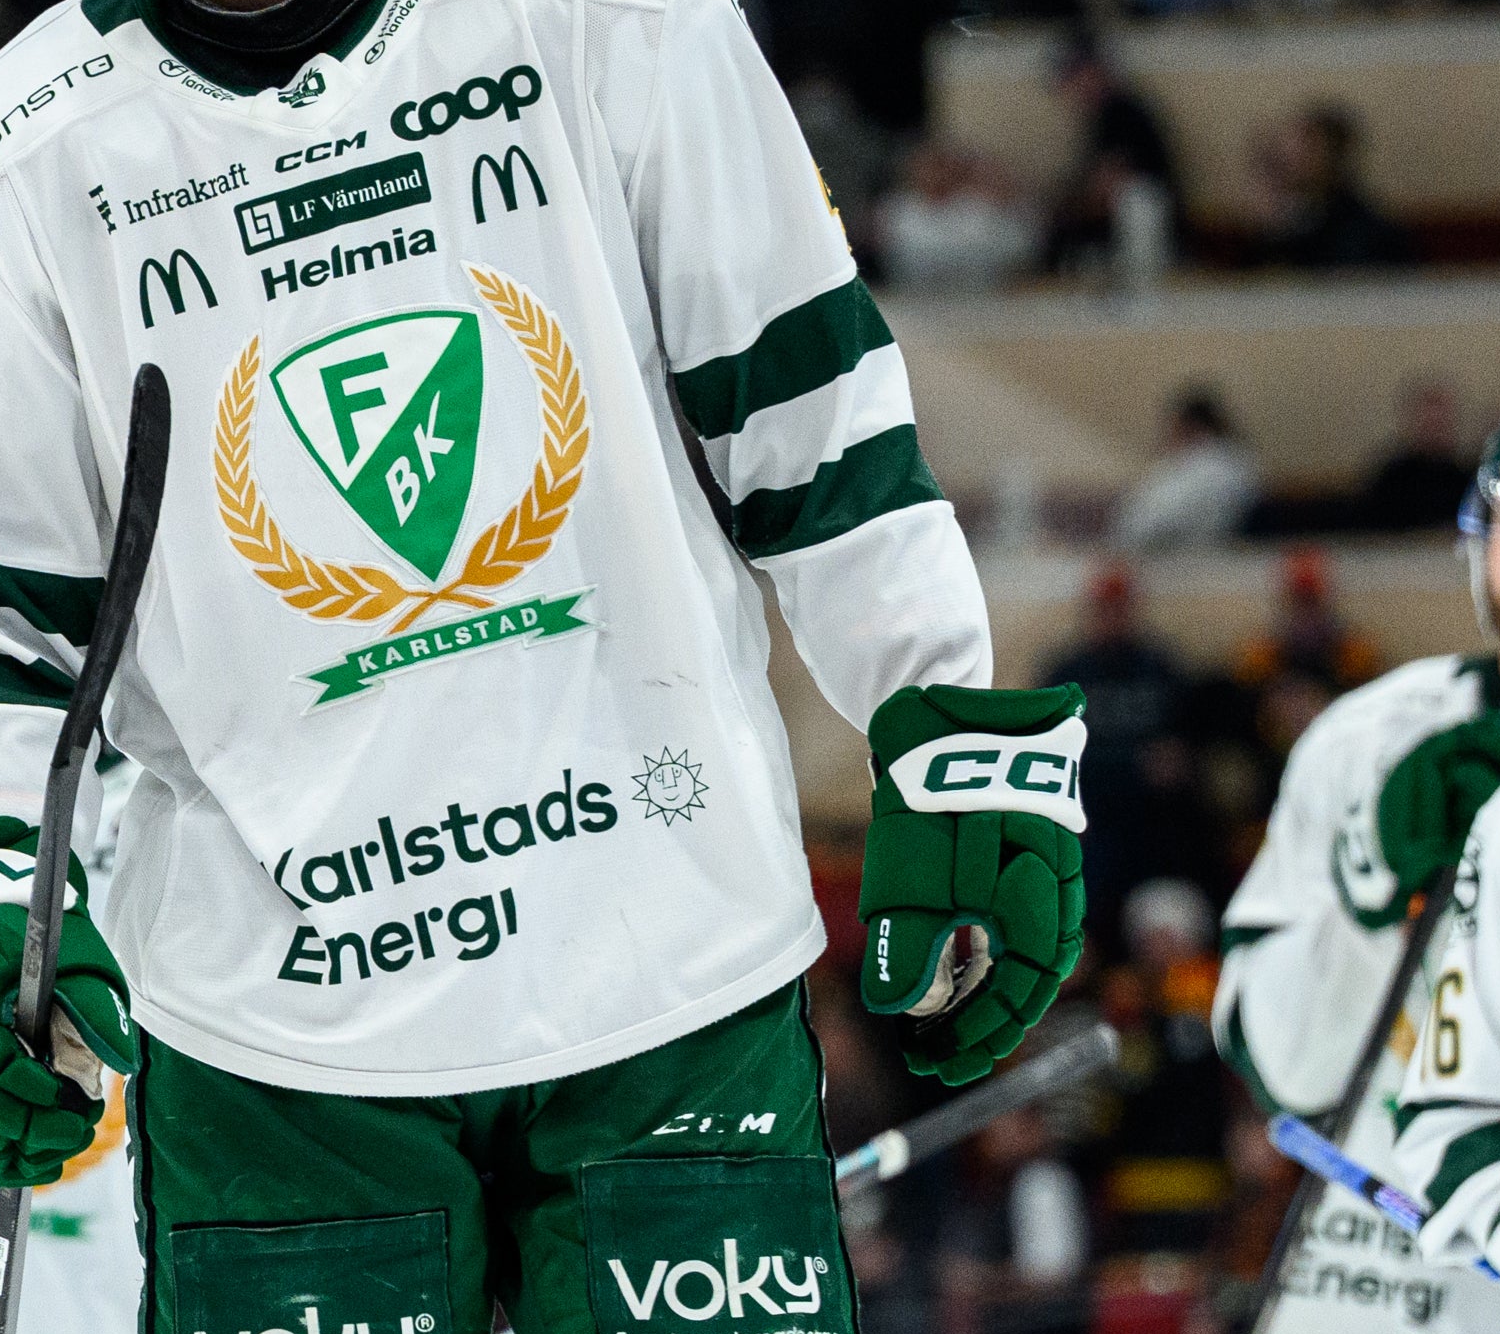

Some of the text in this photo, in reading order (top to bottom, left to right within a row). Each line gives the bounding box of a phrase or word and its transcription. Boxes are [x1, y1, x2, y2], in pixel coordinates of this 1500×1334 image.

[123, 64, 543, 225] Infrakraft CCM coop
[290, 170, 423, 225] LF Värmland
[260, 226, 437, 303] Helmia
[356, 605, 540, 674] KARLSTAD
[276, 885, 519, 987] Energi
[875, 917, 892, 983] CCM
[606, 1238, 822, 1322] voky
